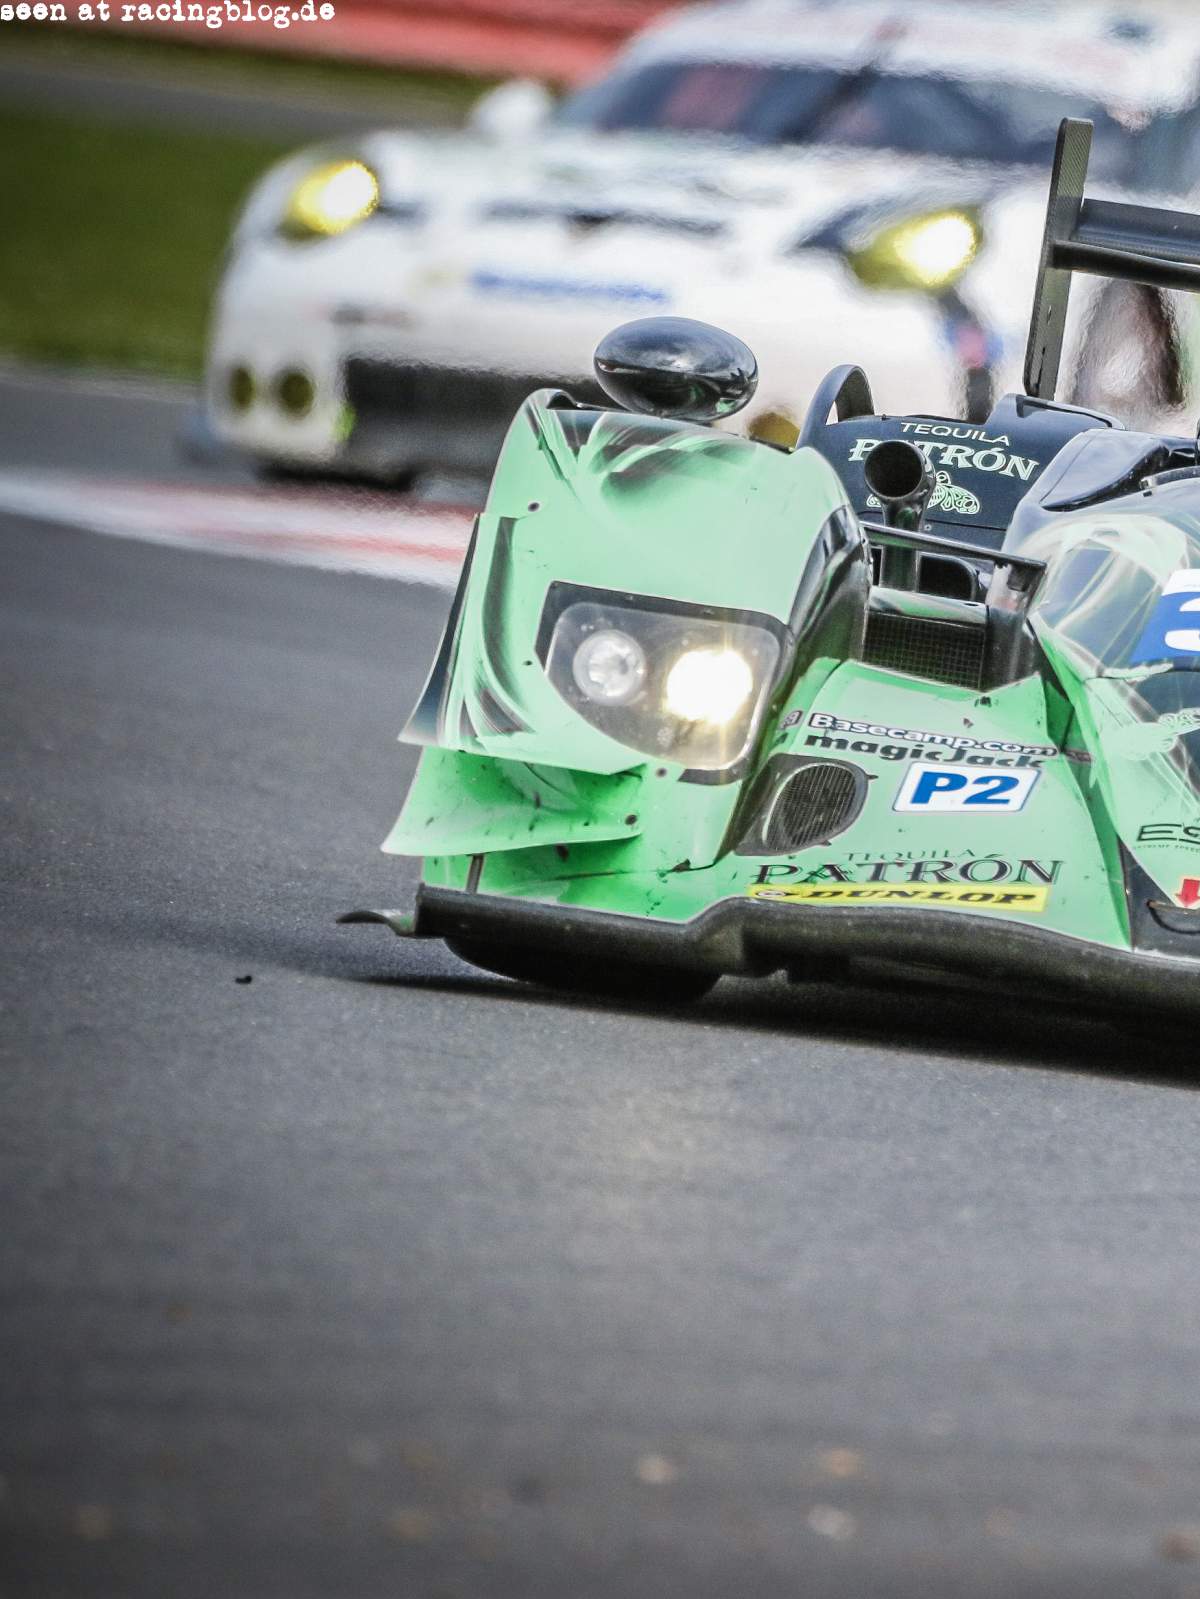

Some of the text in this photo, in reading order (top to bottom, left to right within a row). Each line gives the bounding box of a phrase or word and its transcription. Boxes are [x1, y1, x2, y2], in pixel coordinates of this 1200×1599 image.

[901, 422, 1010, 446] TEQUILA
[848, 438, 1040, 480] PTRÓN
[809, 713, 1057, 757] Basecamp.com
[910, 771, 1020, 805] P2
[752, 853, 1064, 885] PATRÓN
[801, 889, 1036, 905] DUNLOP
